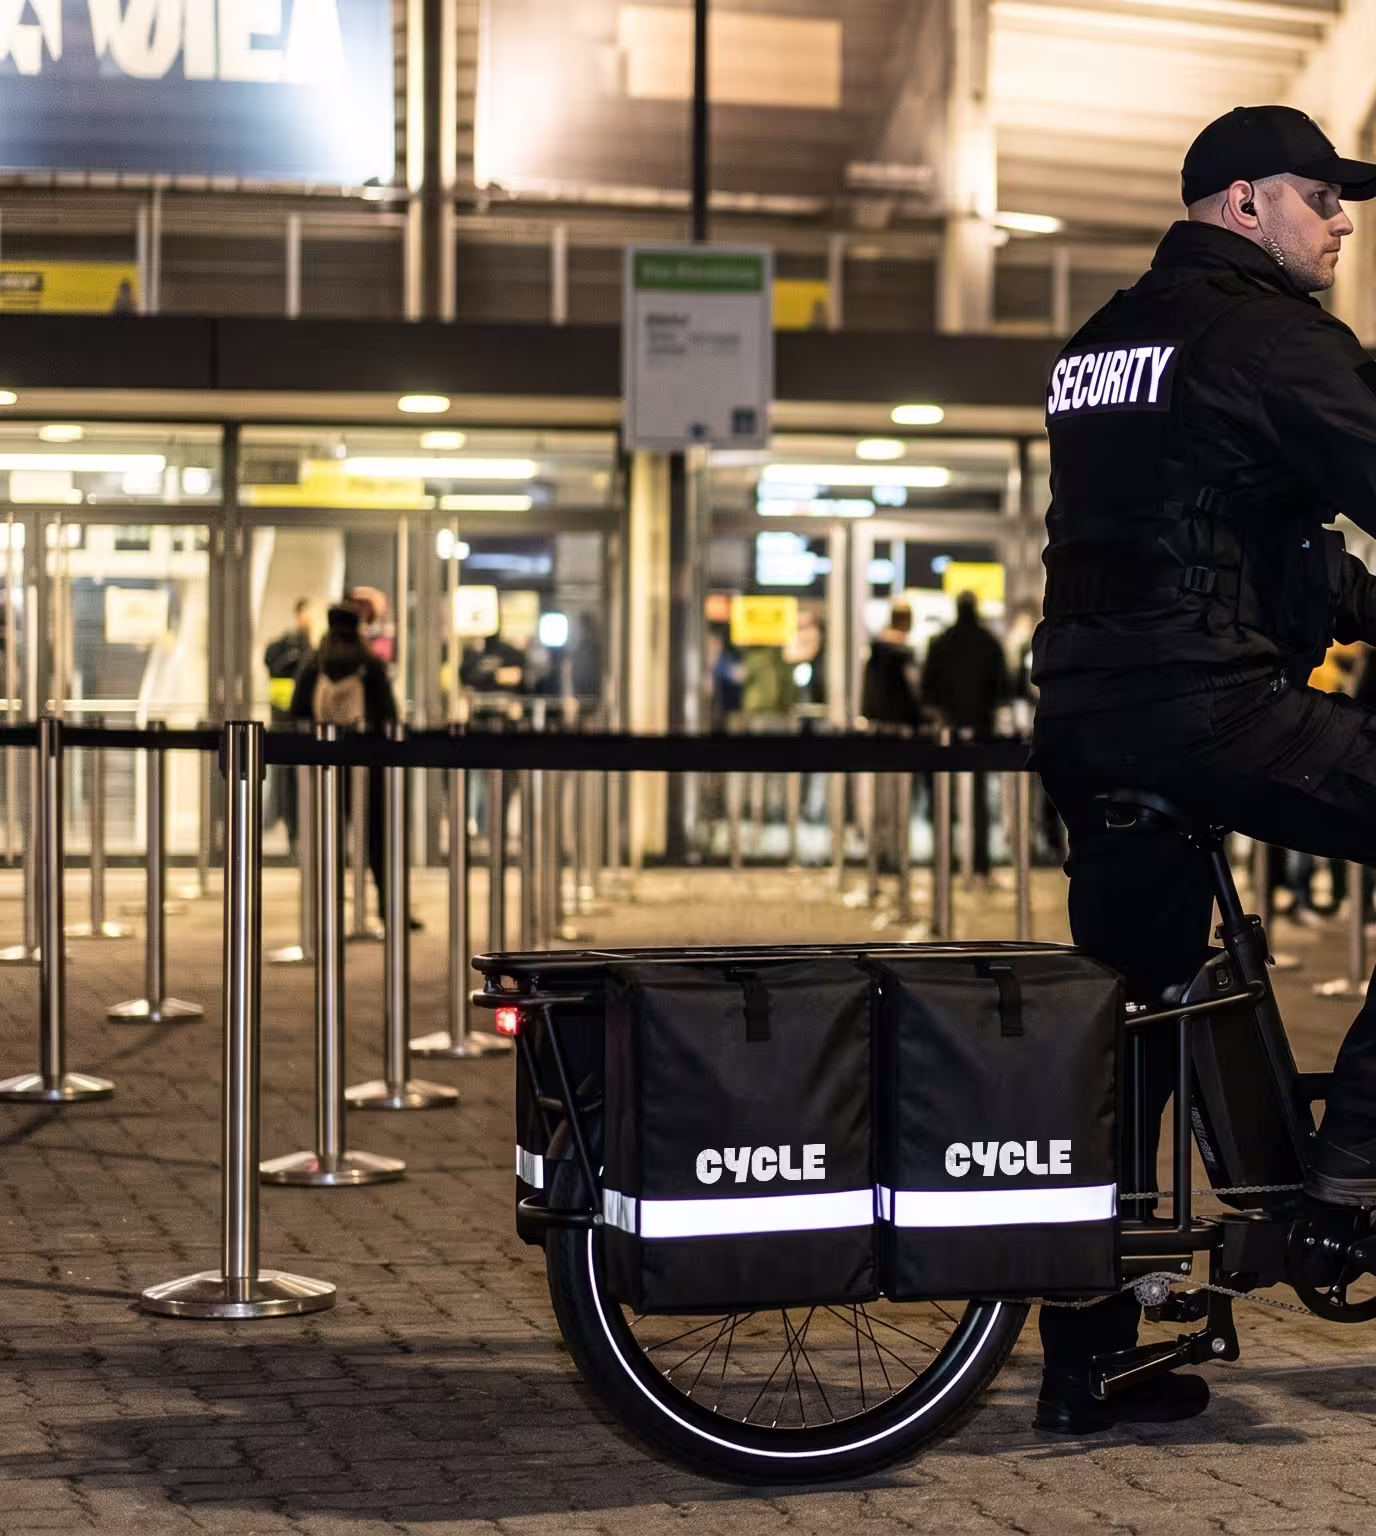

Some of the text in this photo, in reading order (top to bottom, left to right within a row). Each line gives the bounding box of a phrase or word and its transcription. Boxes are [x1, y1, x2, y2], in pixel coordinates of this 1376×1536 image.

[1047, 346, 1175, 415] SECURITY
[695, 1143, 826, 1185] CYCLE
[944, 1139, 1072, 1178] CYCLE
